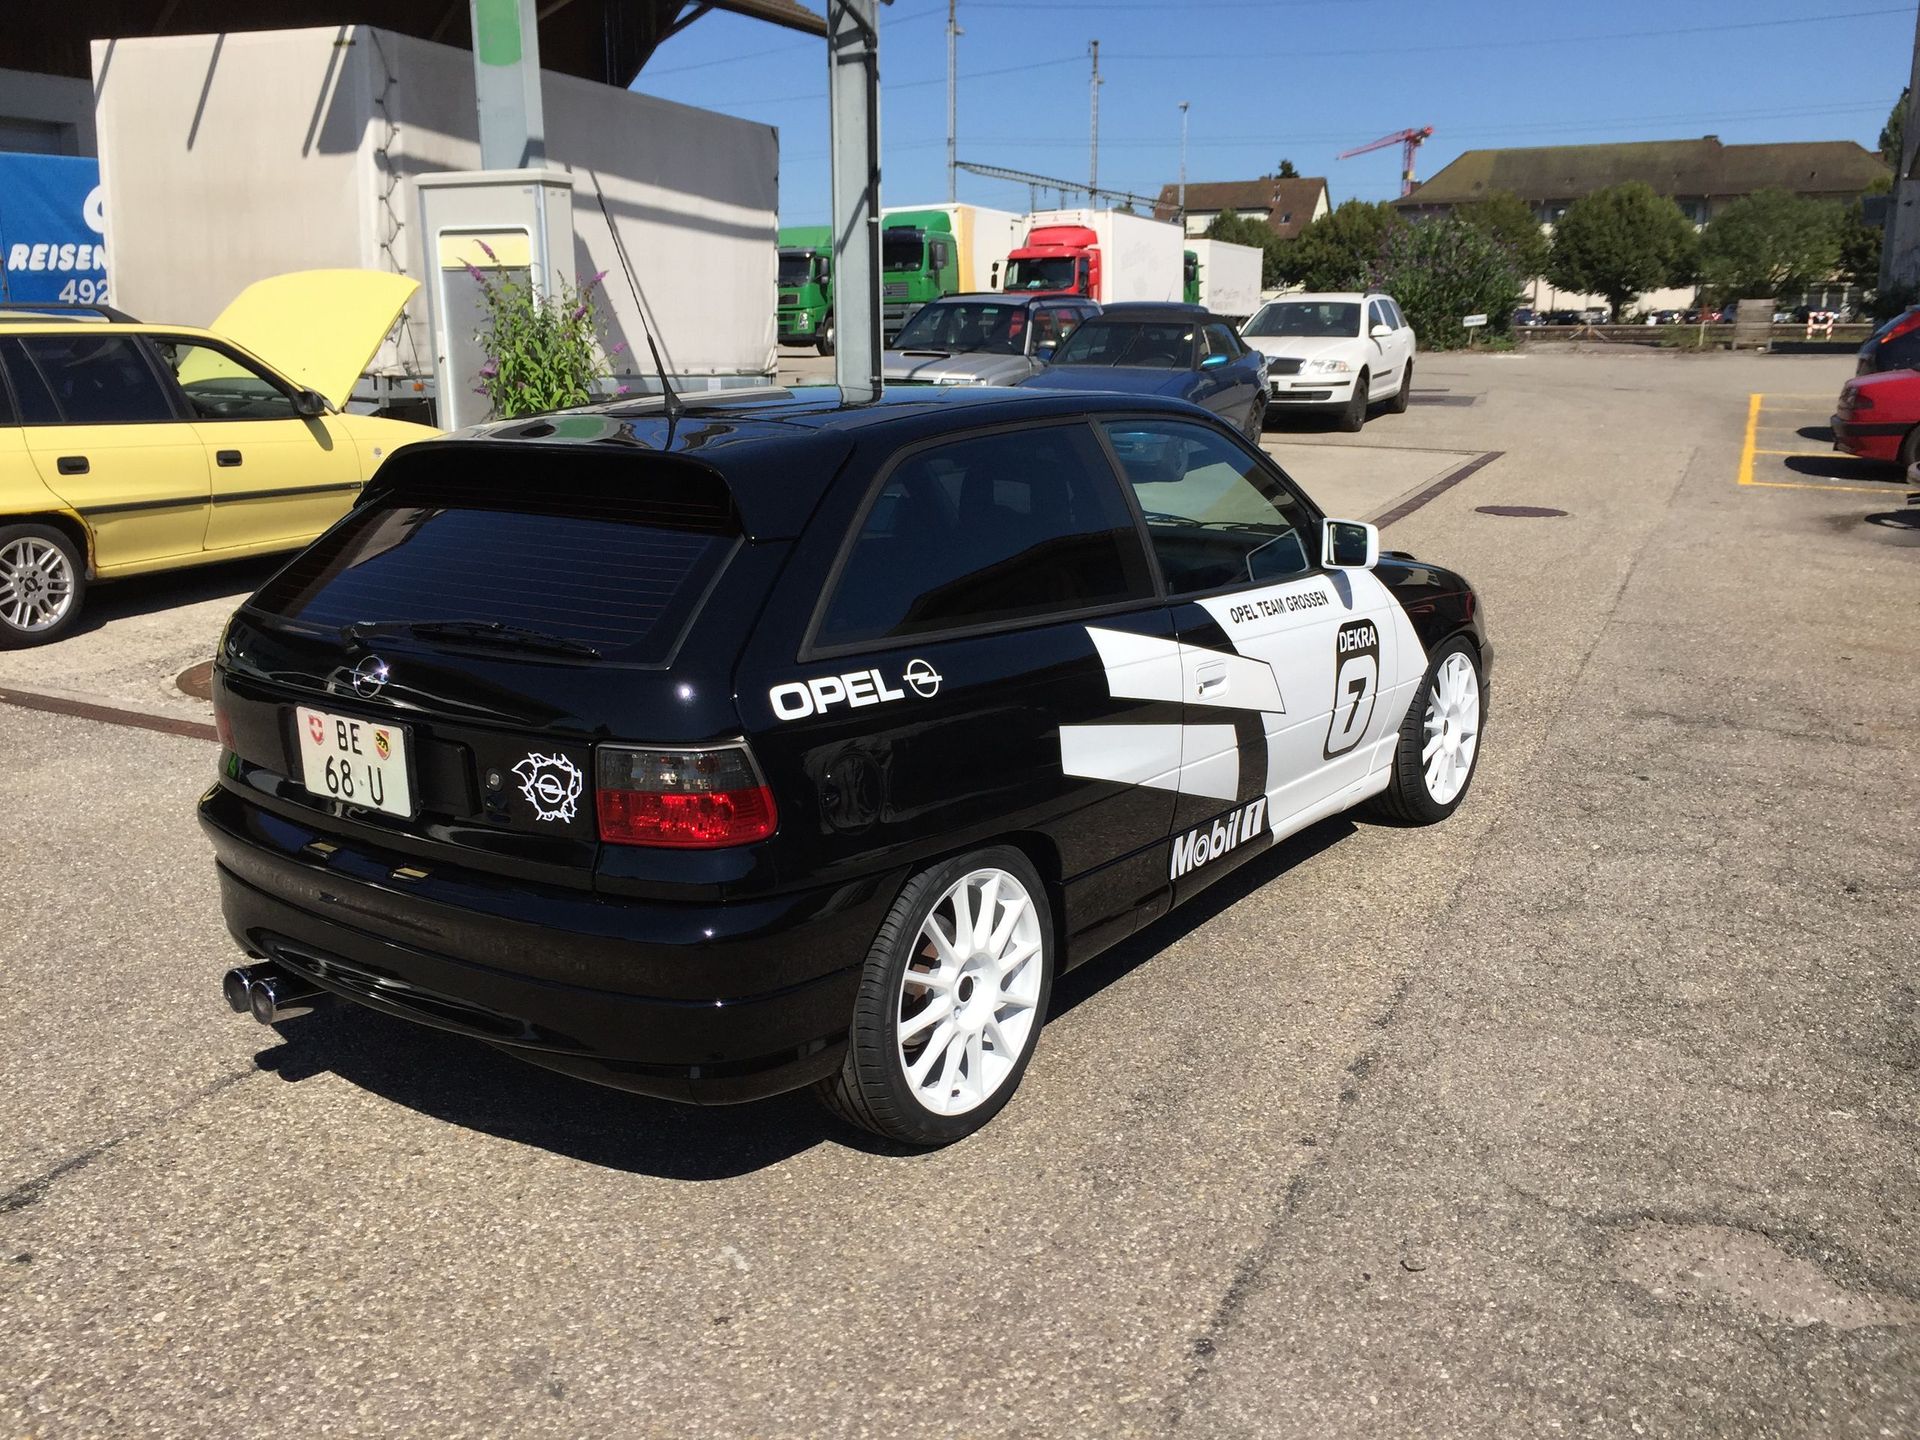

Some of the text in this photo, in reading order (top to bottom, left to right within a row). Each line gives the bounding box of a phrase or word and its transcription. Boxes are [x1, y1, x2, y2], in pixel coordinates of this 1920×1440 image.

[8, 243, 107, 271] REISEN
[59, 279, 109, 304] 492
[1230, 590, 1329, 624] OPEL TEAM GROSSEN
[1339, 625, 1377, 653] DEKRA
[769, 668, 905, 721] OPEL
[1343, 677, 1367, 734] 7
[336, 720, 362, 755] BE
[325, 755, 384, 806] 68 U
